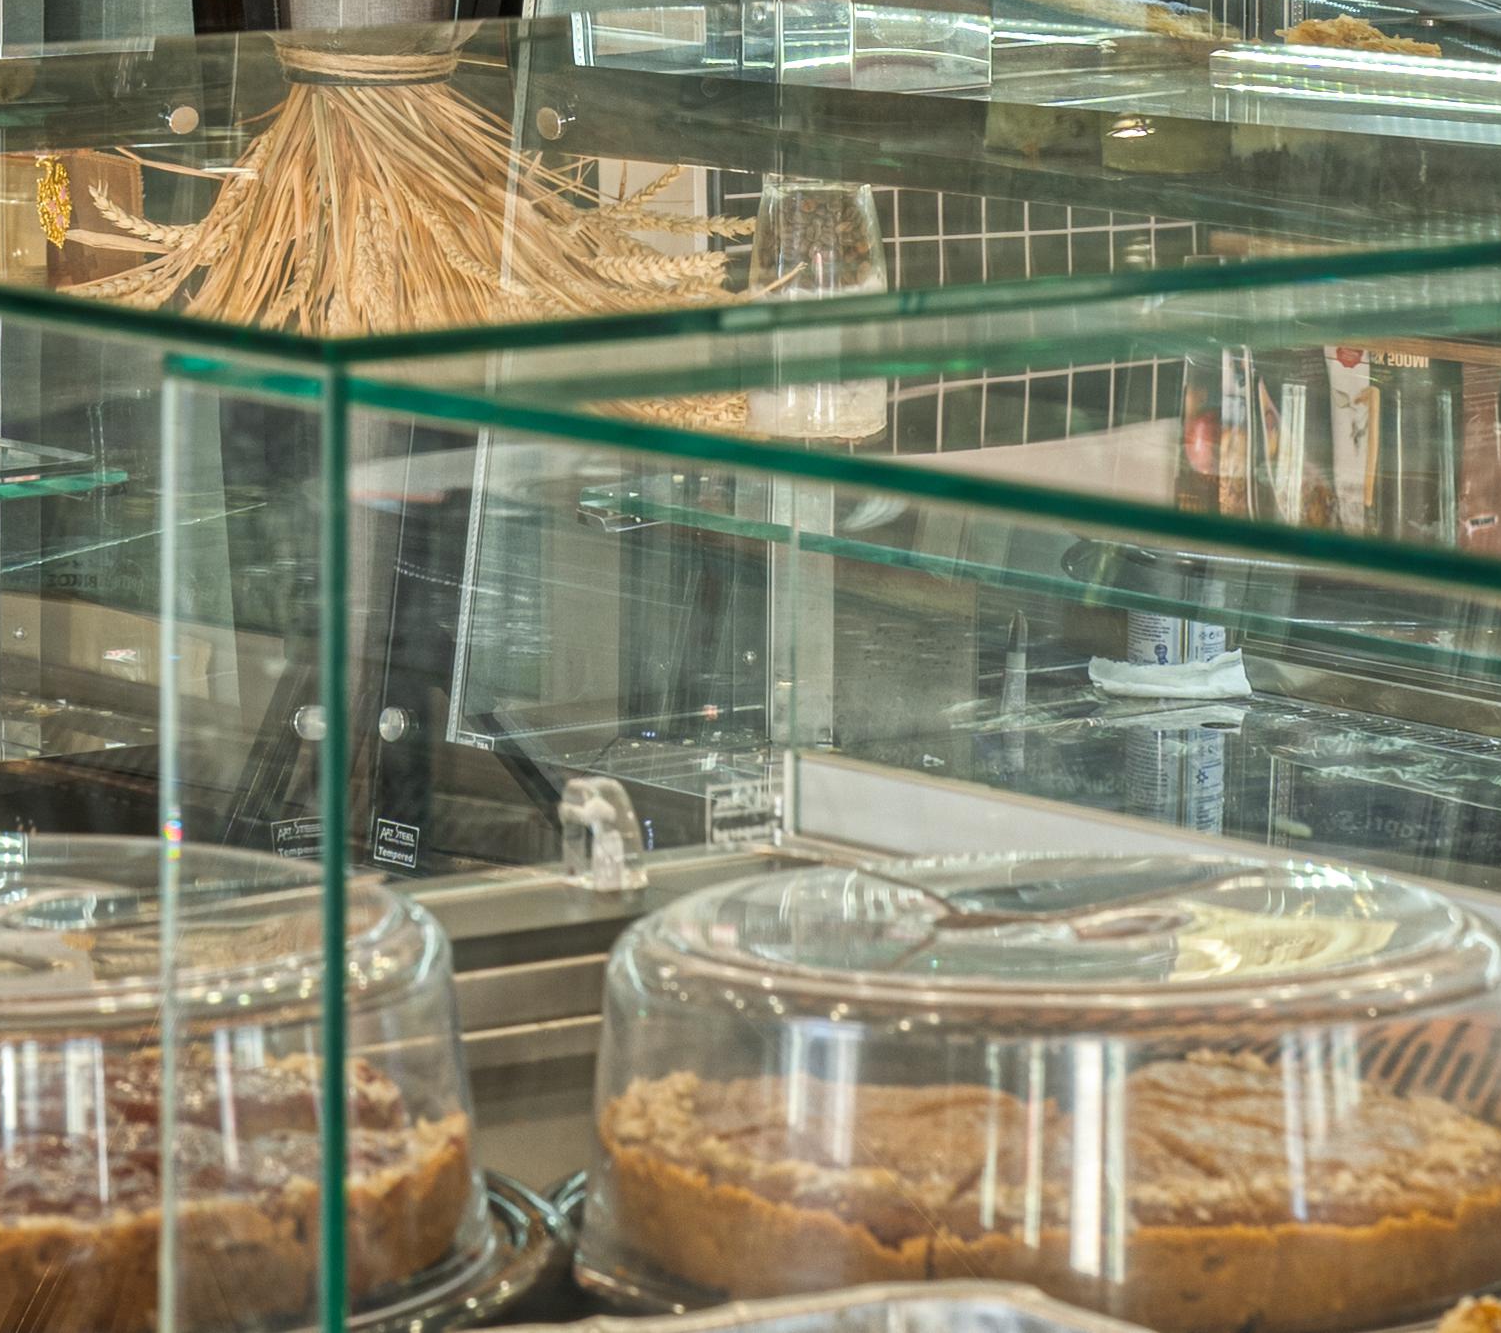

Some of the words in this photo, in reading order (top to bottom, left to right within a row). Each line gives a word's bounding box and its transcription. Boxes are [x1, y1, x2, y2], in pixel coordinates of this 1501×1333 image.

[381, 826, 394, 840] ART
[395, 824, 415, 843] STEEL
[378, 846, 414, 863] Tempered
